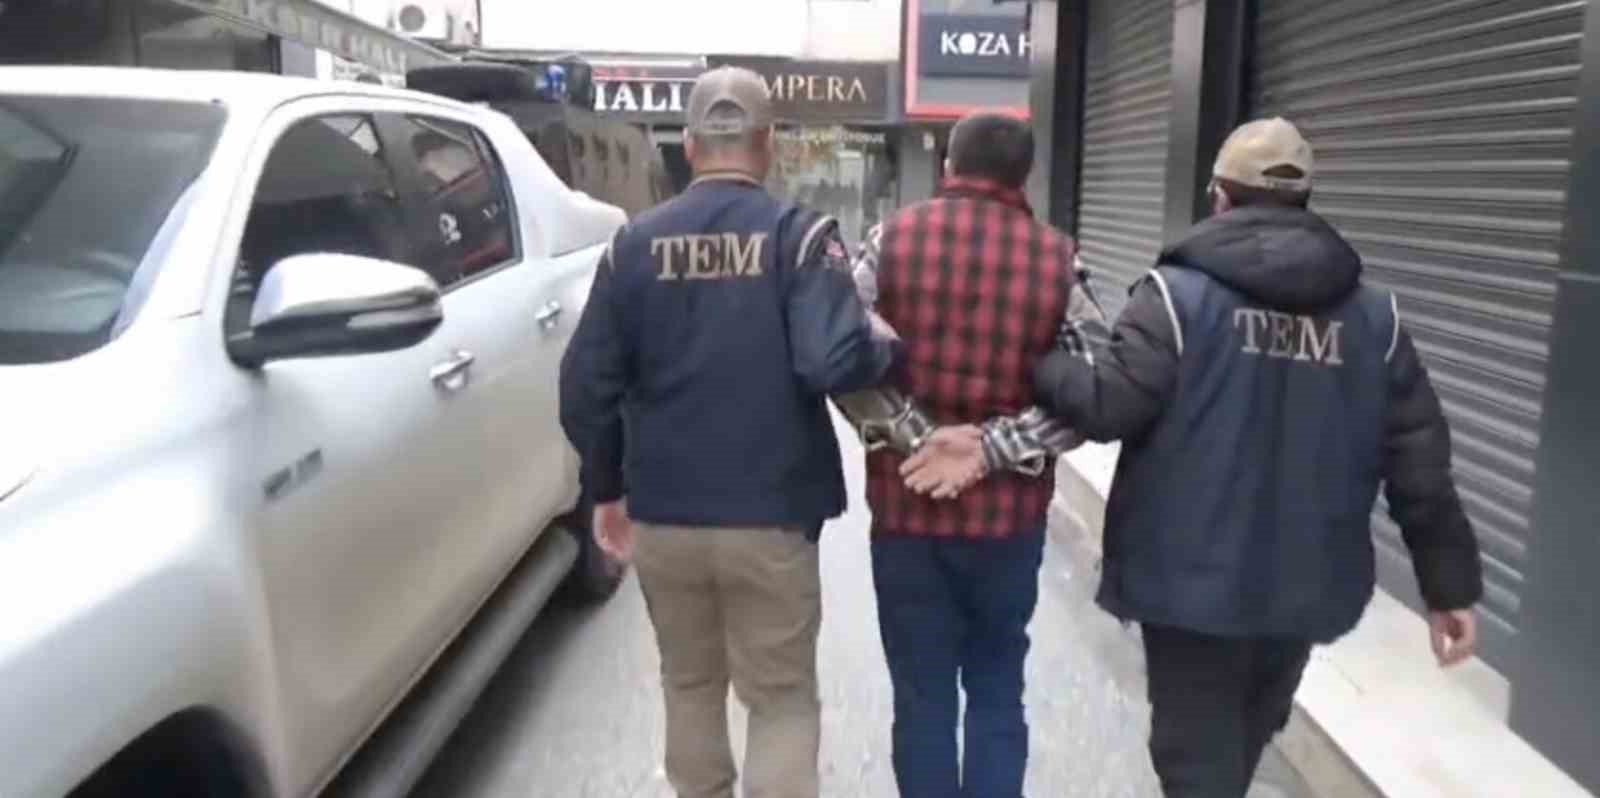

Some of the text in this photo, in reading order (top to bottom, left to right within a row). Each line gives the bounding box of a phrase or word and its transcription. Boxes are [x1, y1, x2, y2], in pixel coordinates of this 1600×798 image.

[941, 31, 1010, 55] KOZA
[651, 232, 768, 281] TEM
[1233, 308, 1344, 365] TEM
